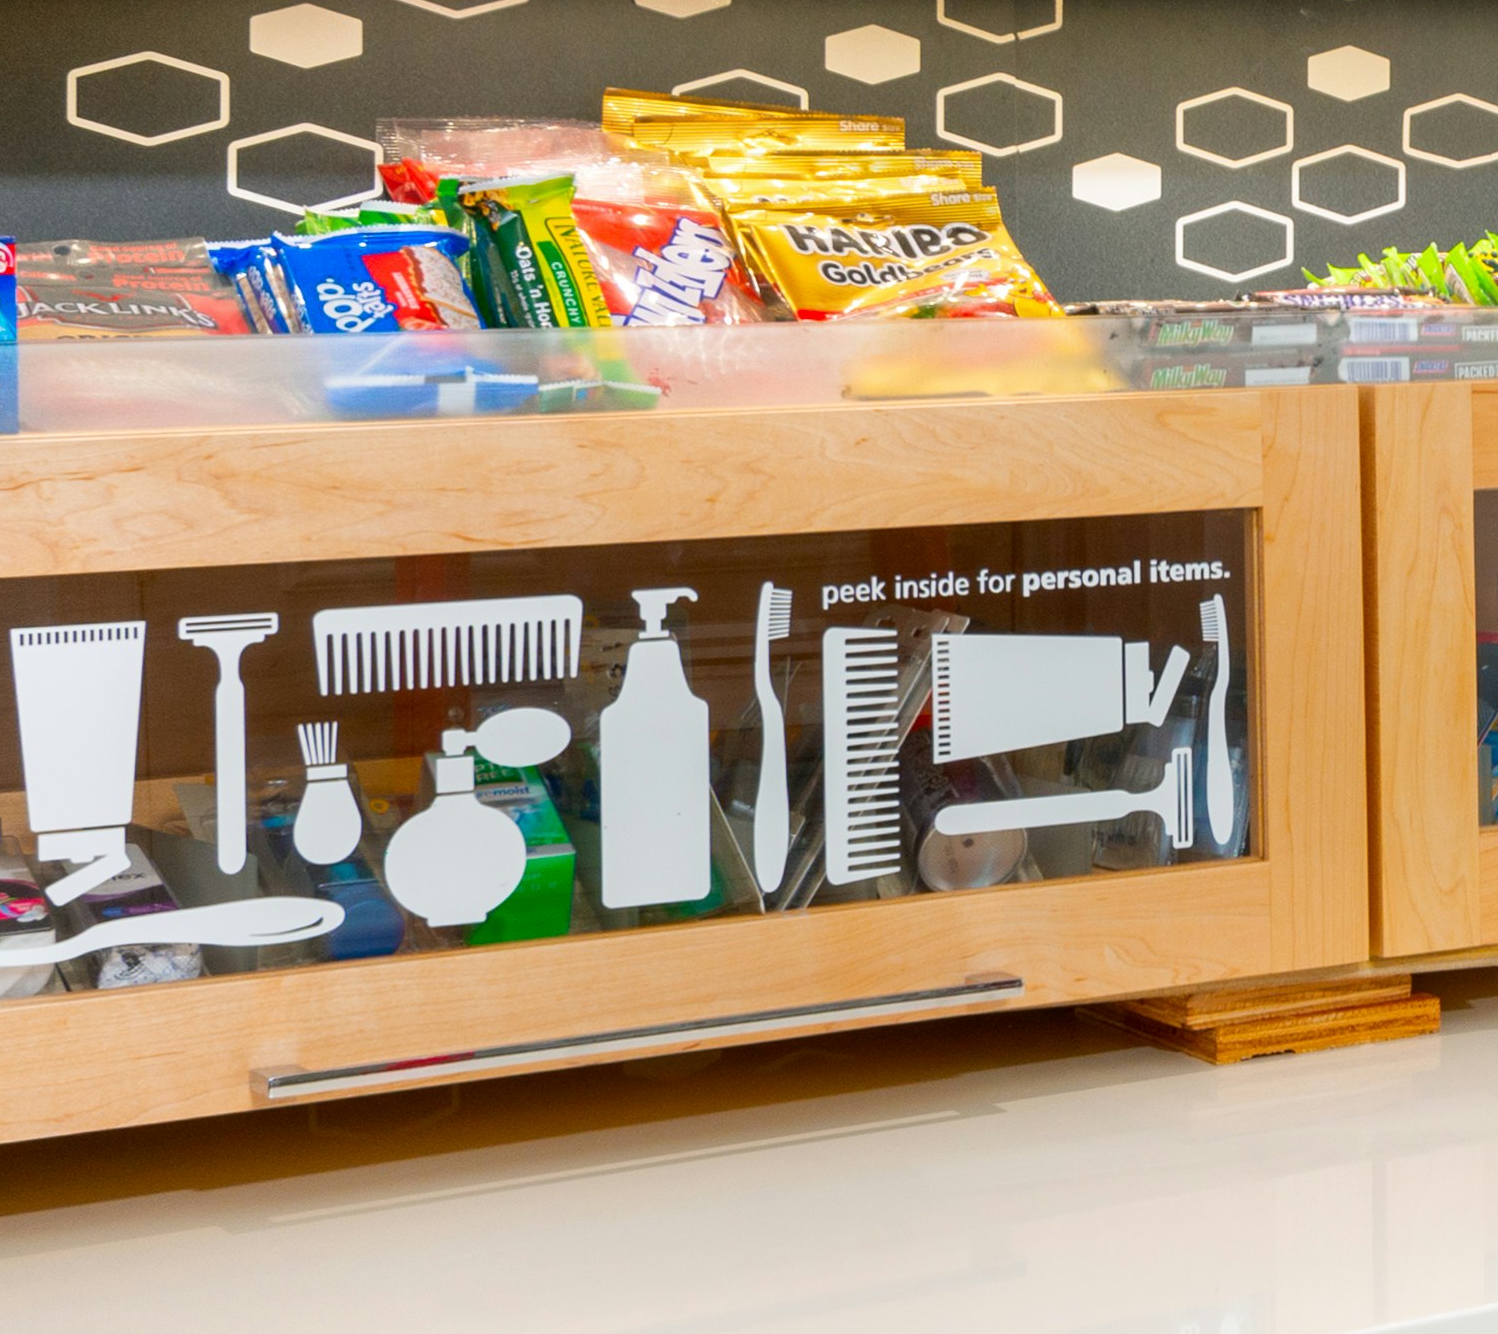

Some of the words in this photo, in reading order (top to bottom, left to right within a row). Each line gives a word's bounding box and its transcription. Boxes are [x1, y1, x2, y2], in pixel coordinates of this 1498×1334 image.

[838, 120, 880, 133] Share
[929, 193, 971, 207] Share
[554, 224, 599, 292] NATURE
[782, 222, 991, 260] HARIBO
[514, 244, 536, 283] Oats
[820, 247, 1000, 286] Goldbears
[111, 278, 211, 293] Protein
[550, 261, 584, 325] CRUNCHY
[17, 301, 105, 318] JACK
[109, 301, 218, 328] LINK'S
[1458, 364, 1494, 379] PACKED
[821, 576, 887, 611] peek
[893, 571, 970, 601] inside
[976, 568, 1013, 595] for
[1022, 560, 1142, 598] personal
[1149, 558, 1232, 585] items.
